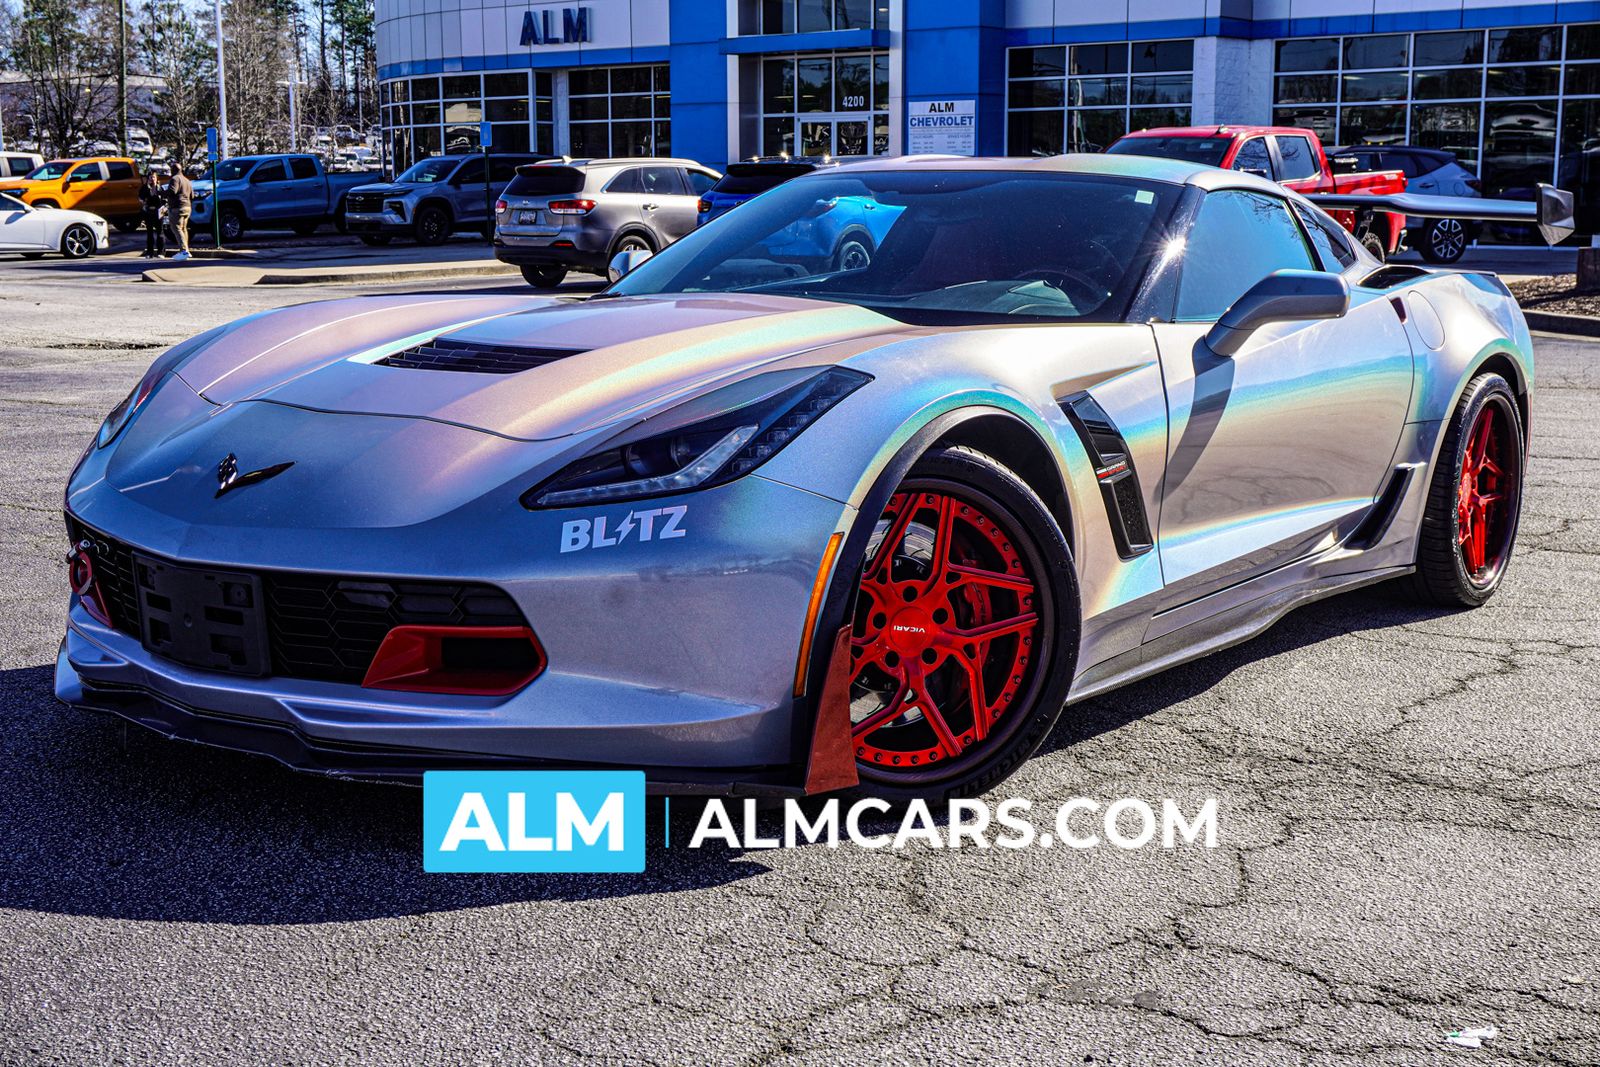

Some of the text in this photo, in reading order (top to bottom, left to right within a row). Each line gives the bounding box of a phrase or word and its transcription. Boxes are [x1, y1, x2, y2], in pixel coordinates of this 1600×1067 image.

[520, 7, 590, 46] ALM
[842, 95, 864, 107] 4200
[929, 102, 955, 113] ALM
[910, 116, 974, 127] CHEVROLET
[560, 505, 688, 553] BLITZ
[893, 625, 926, 633] VICARI
[949, 738, 1033, 799] MICHELIN
